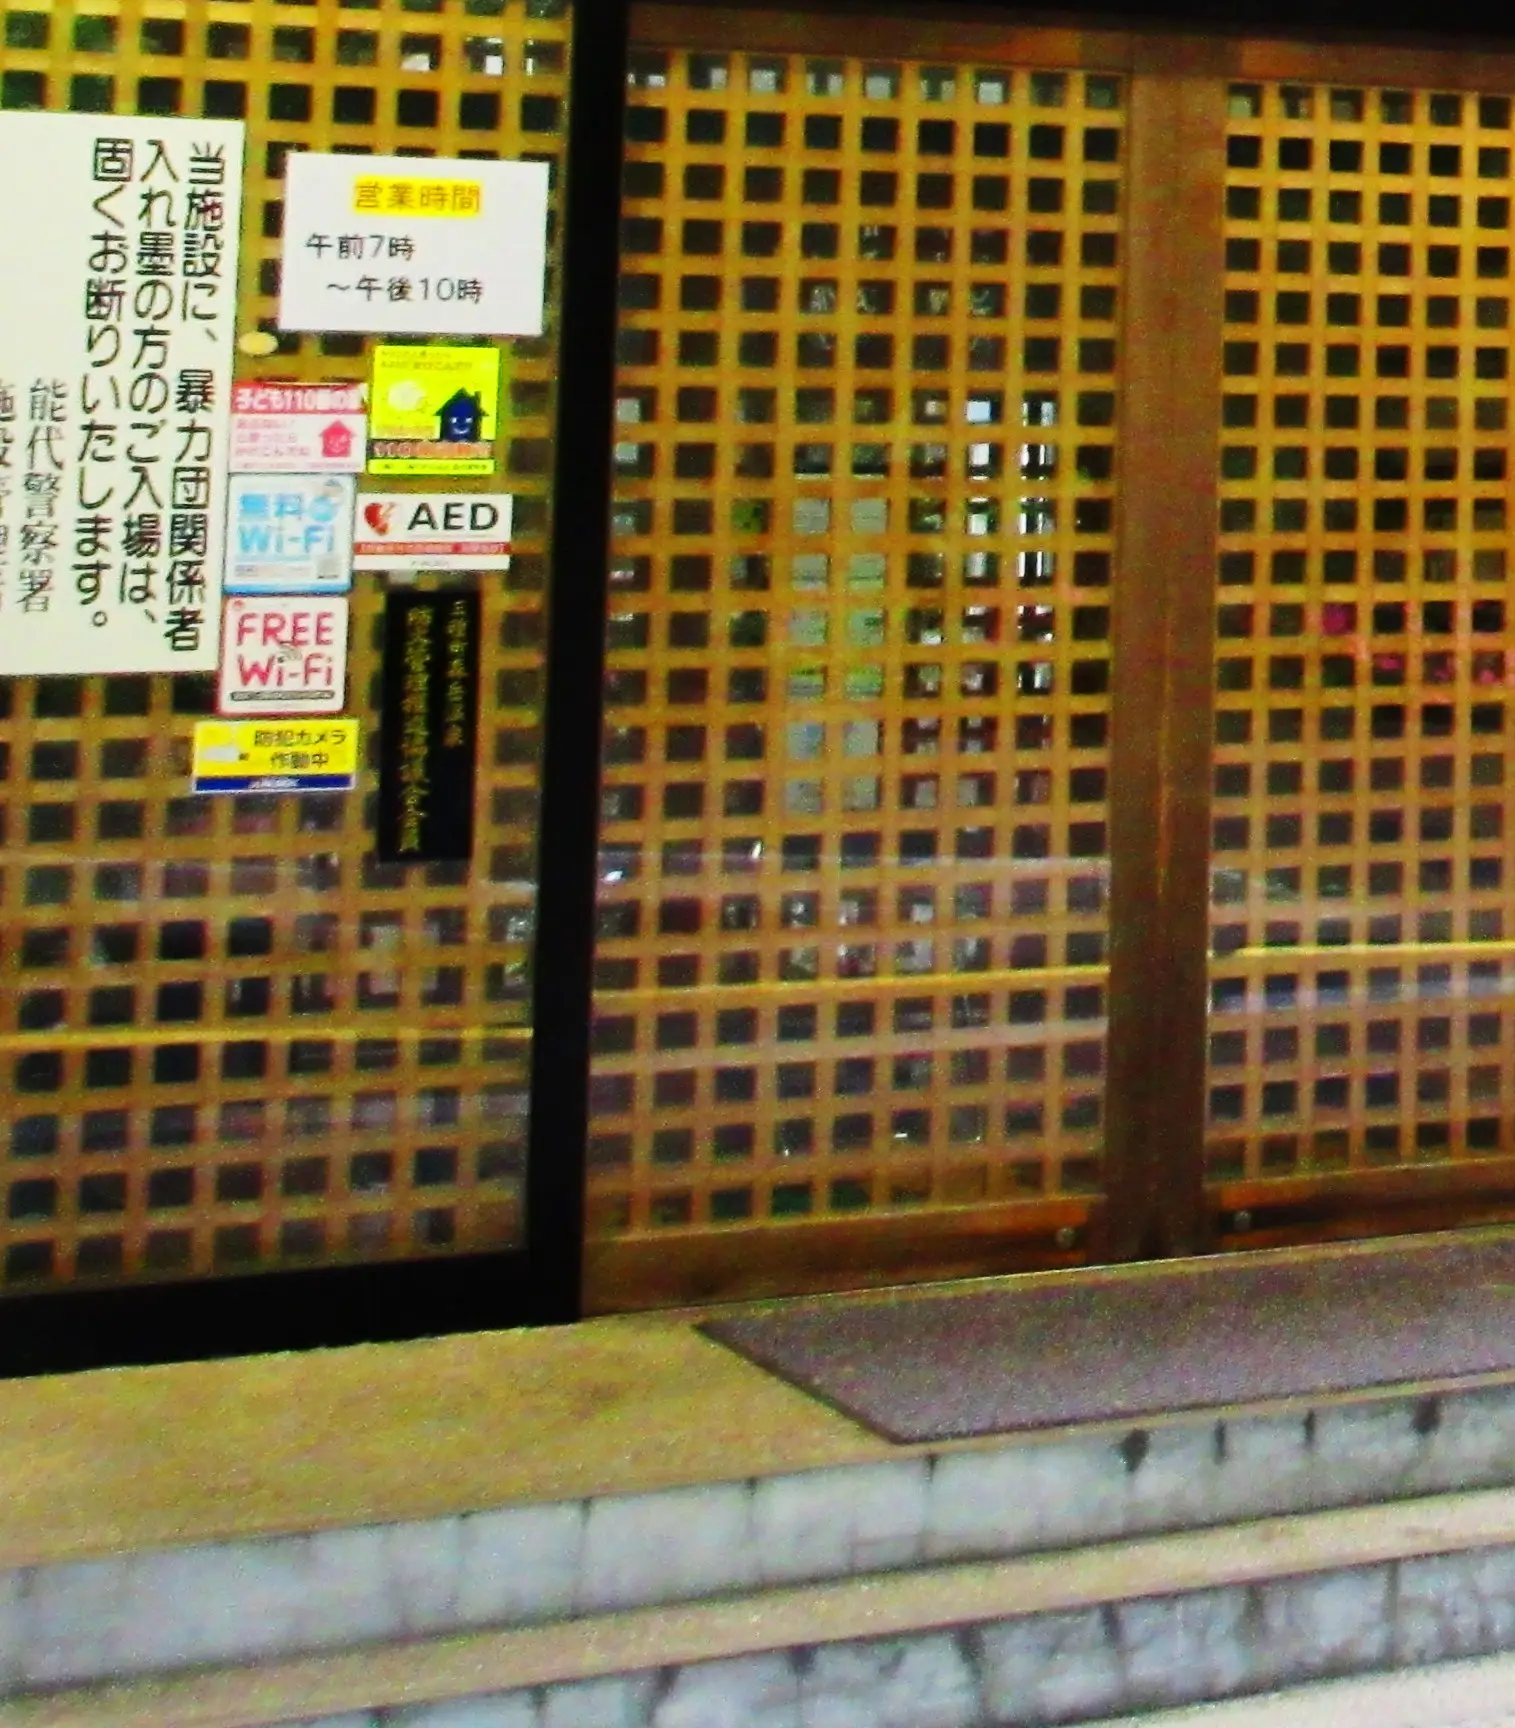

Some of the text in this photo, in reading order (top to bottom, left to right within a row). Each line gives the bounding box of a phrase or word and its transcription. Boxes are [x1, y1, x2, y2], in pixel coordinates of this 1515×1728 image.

[355, 182, 481, 213] 営業時間
[306, 233, 416, 261] 午前7時
[72, 138, 134, 630] 固くお断りいたします。
[16, 377, 68, 614] 能代警察署
[407, 502, 499, 531] AED
[237, 524, 335, 553] Wi-Fi
[236, 612, 334, 646] FREE
[238, 653, 333, 687] Wi-Fi
[255, 728, 346, 747] 防犯カメラ
[270, 750, 330, 769] 作動中
